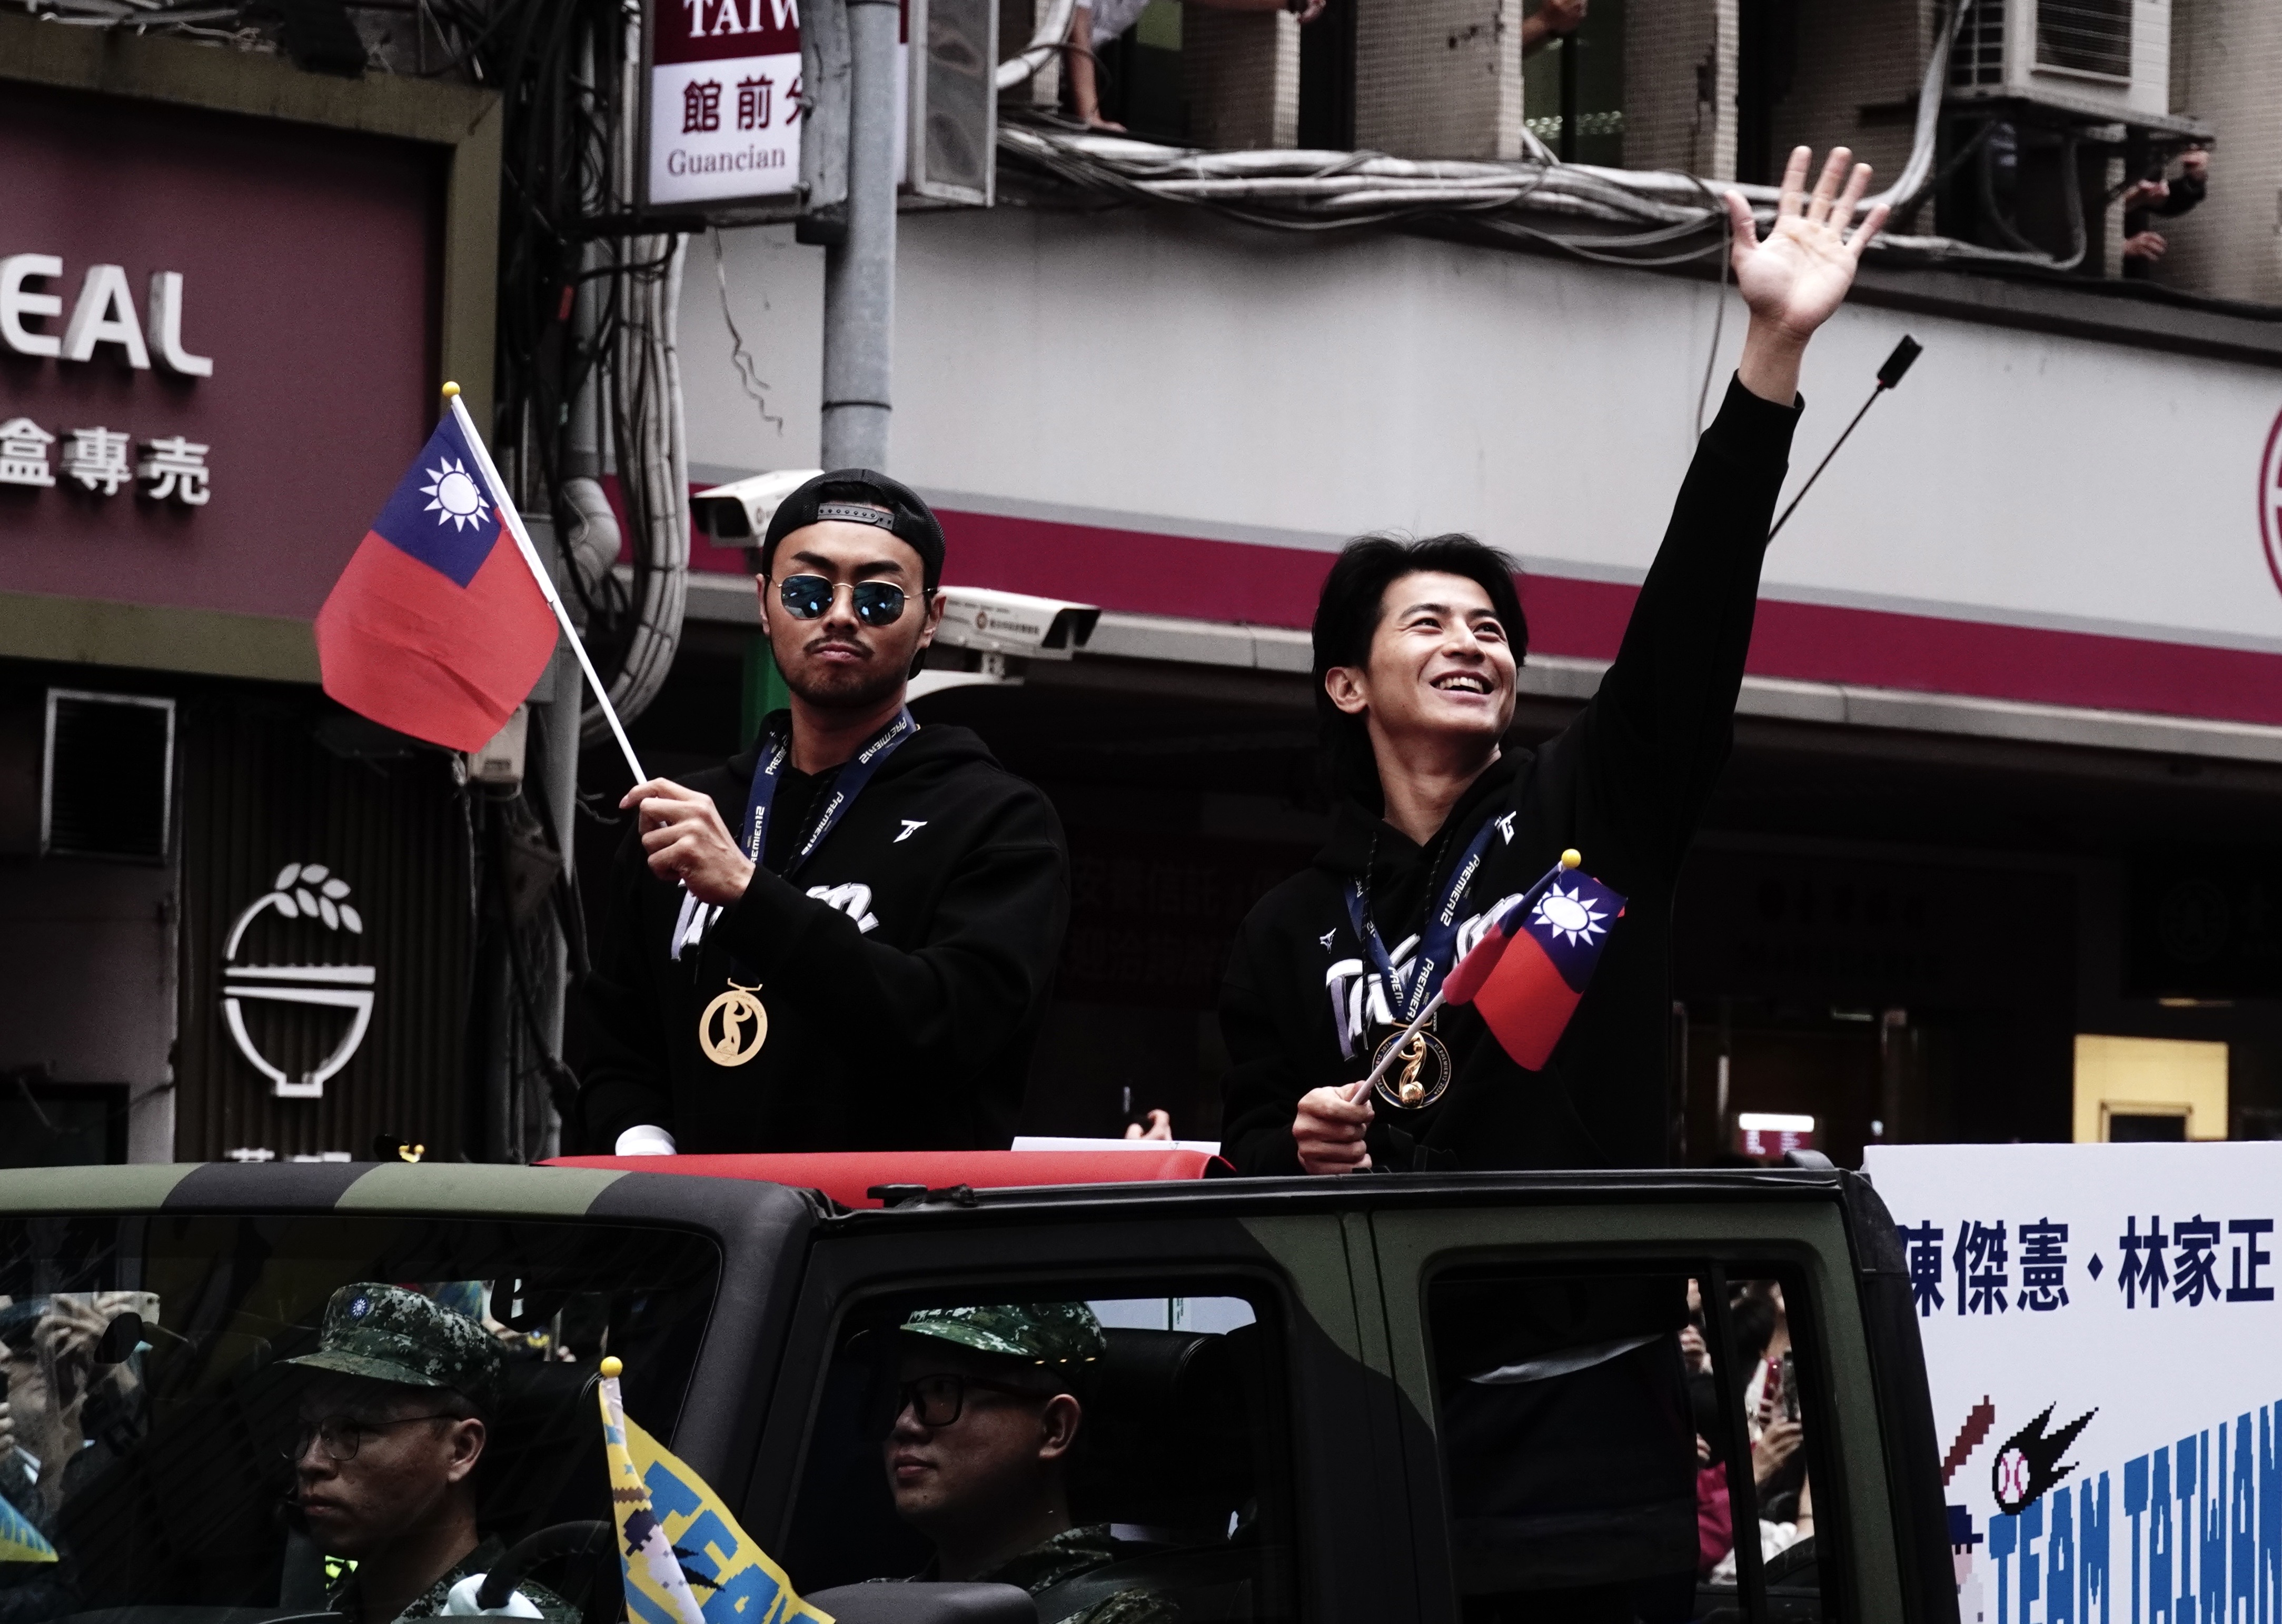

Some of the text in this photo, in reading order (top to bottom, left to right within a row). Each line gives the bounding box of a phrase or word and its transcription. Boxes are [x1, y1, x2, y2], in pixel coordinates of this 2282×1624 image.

[668, 145, 785, 175] Guancian
[0, 253, 213, 378] EAL
[859, 716, 907, 764] PREMIER12
[750, 805, 765, 863] REMIER12
[801, 791, 845, 855] PREMIER12
[1440, 853, 1481, 927] PREMIER12
[2124, 1398, 2282, 1624] TAIWAN
[1989, 1469, 2110, 1624] TEAM
